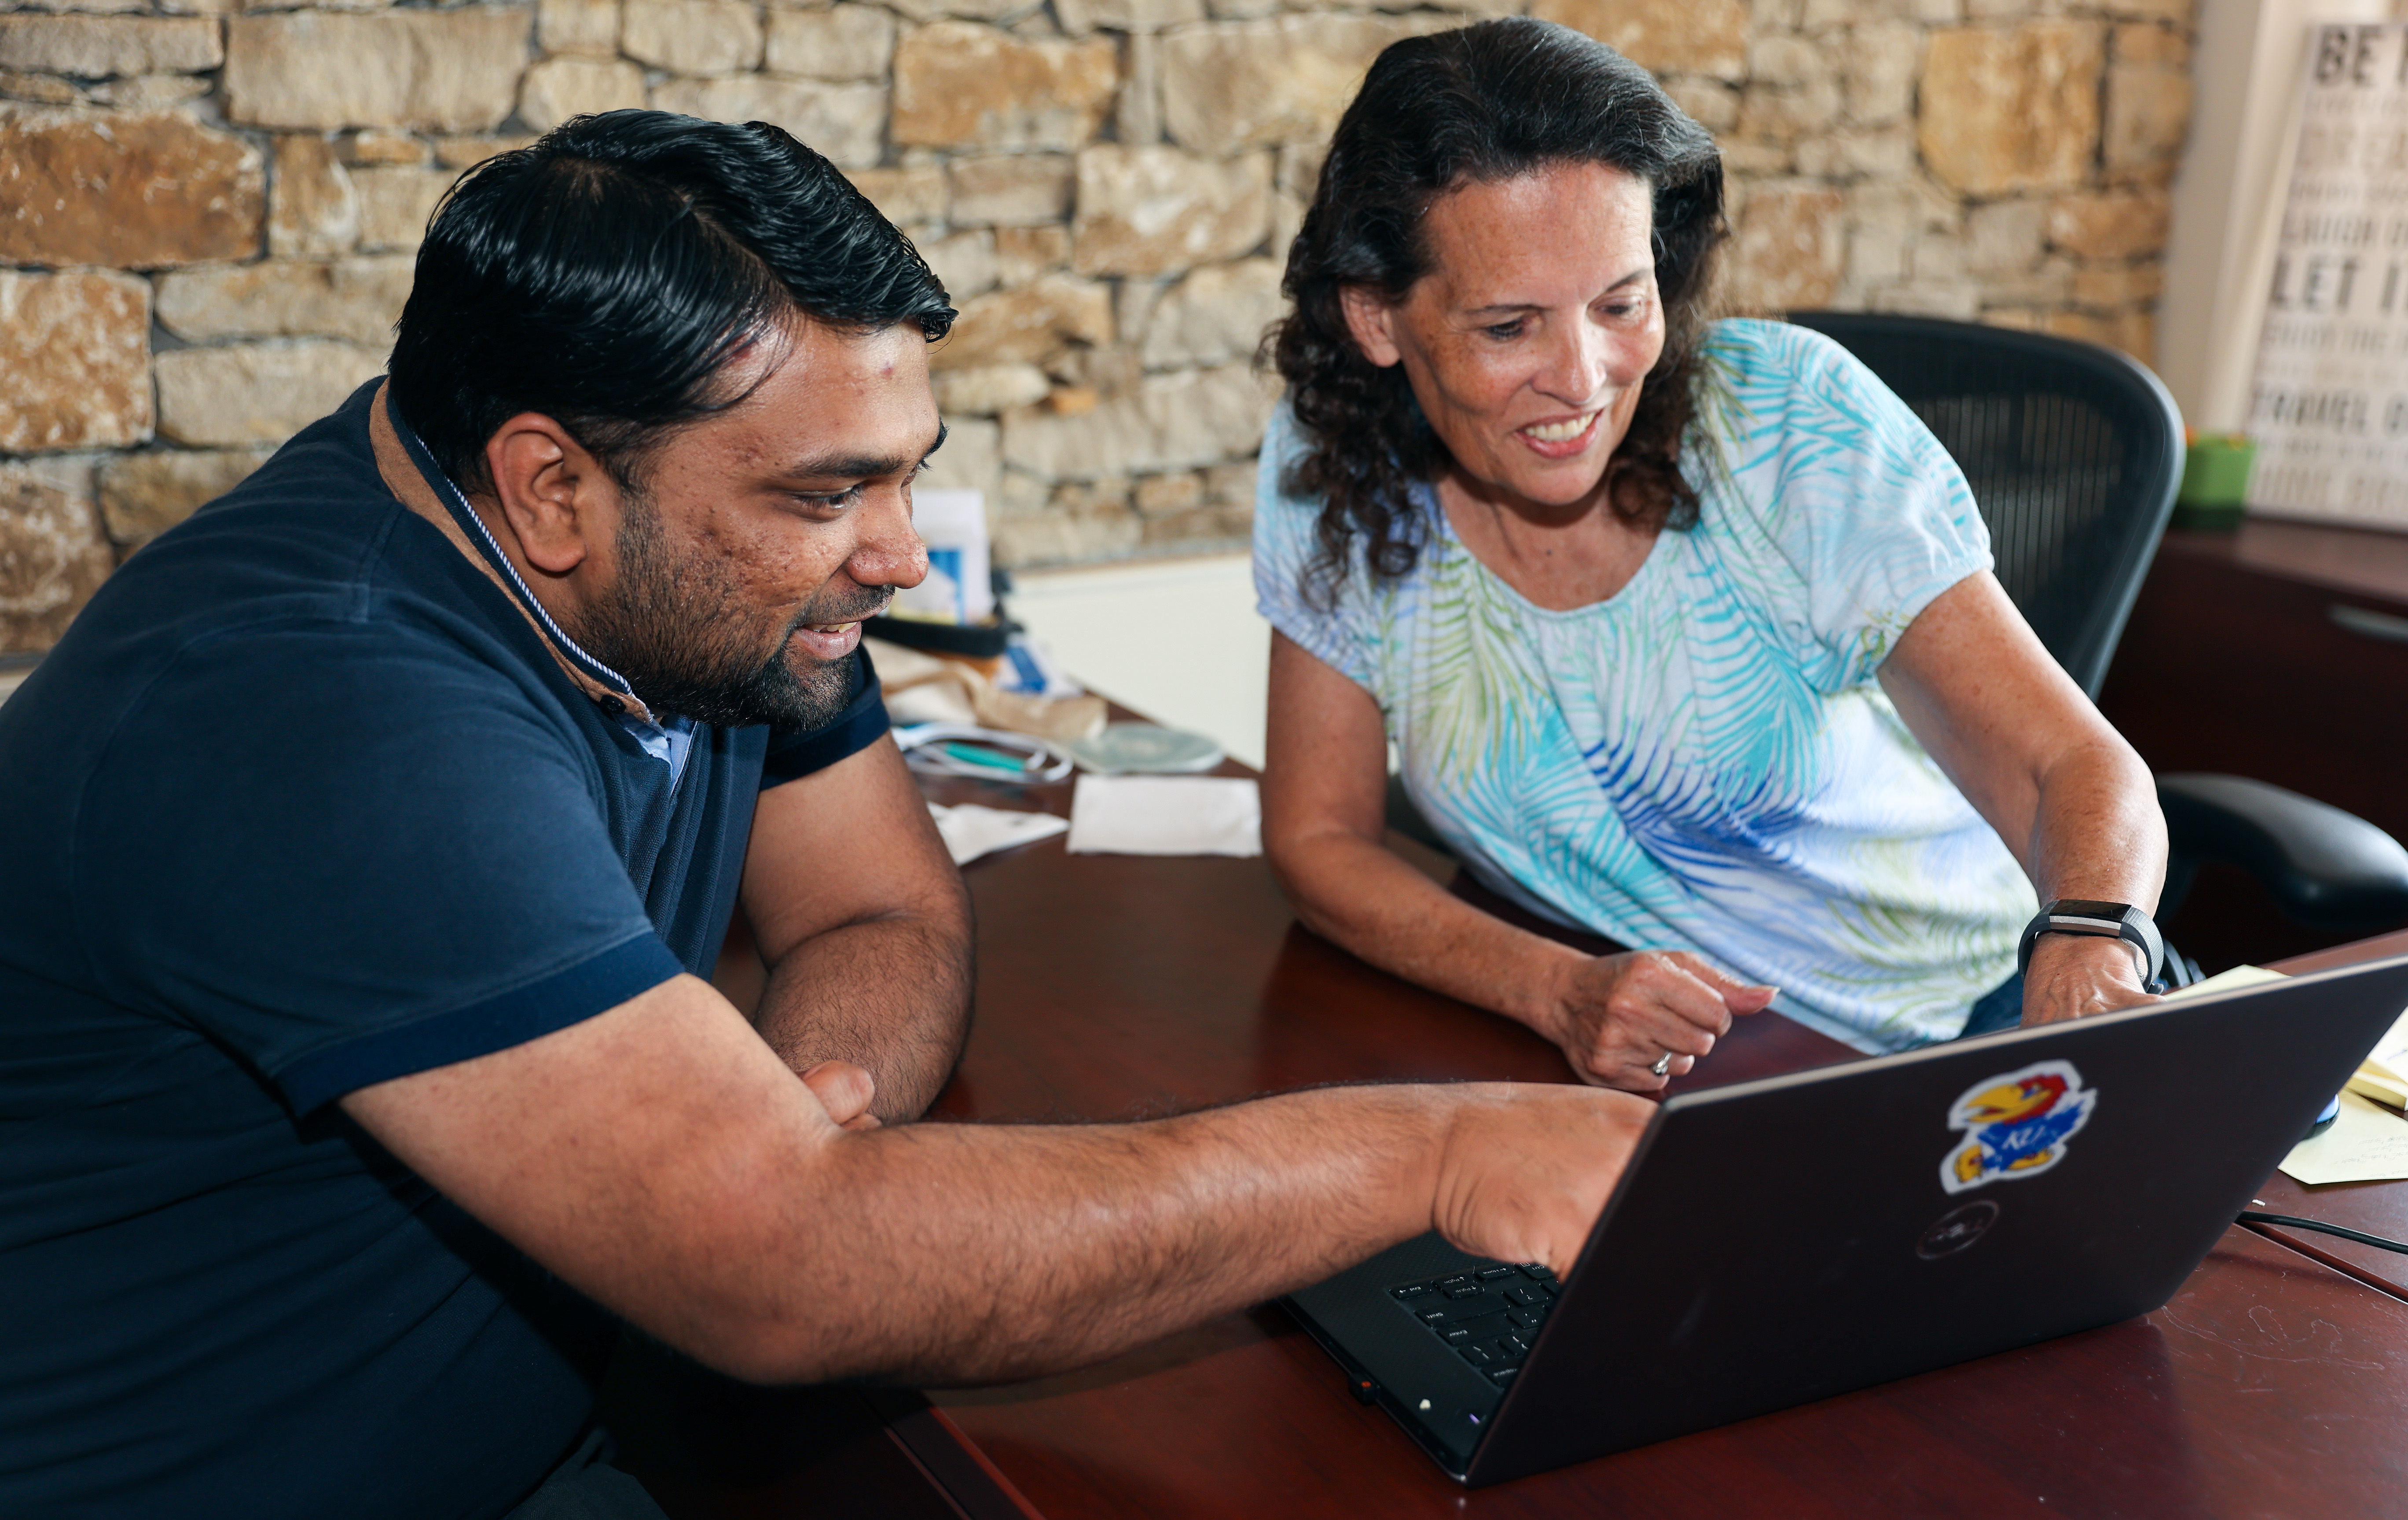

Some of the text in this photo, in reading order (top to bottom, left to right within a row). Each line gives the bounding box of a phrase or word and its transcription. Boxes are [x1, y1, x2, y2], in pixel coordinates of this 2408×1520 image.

[2313, 24, 2386, 90] BE
[2269, 253, 2360, 314] LET
[2002, 1126, 2046, 1150] KU
